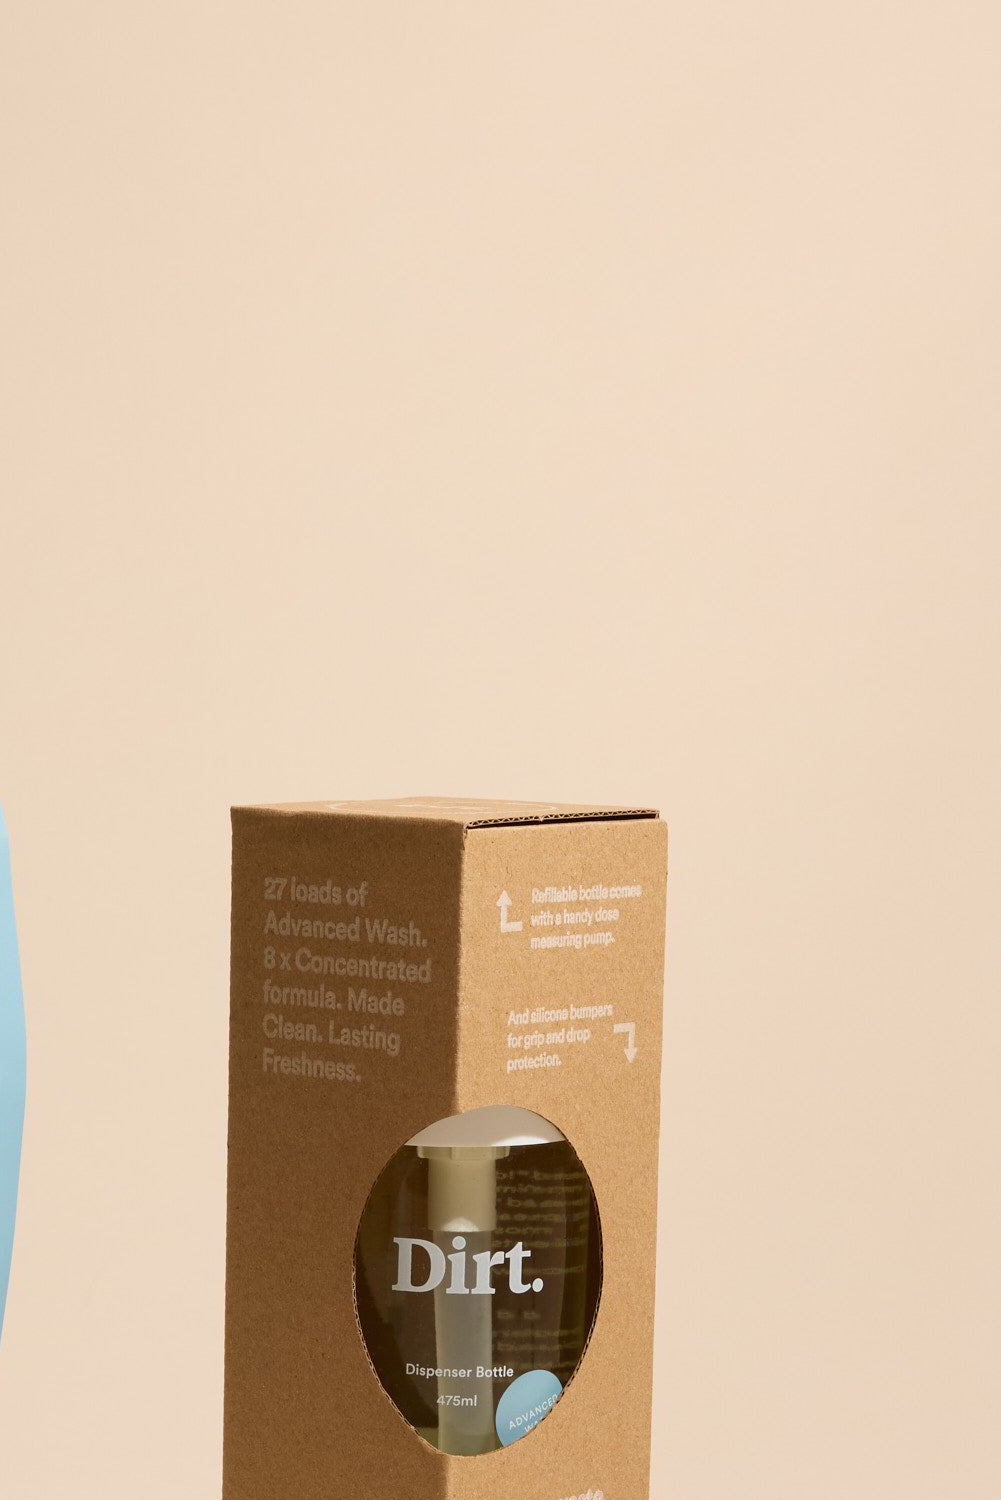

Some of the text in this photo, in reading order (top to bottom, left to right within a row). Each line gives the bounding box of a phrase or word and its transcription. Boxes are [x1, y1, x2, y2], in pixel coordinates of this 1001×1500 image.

[264, 876, 369, 907] 27 loads of
[263, 910, 428, 948] Advanced Wash.
[531, 910, 553, 926] with
[564, 908, 593, 926] handy
[595, 907, 619, 921] dose
[264, 946, 432, 983] 8 x Concentrated
[263, 979, 405, 1016] formula. Made
[507, 1004, 613, 1025] And silicone bumpers
[263, 1013, 400, 1057] Clean. Lasting
[507, 1027, 591, 1049] for grip and drop
[263, 1047, 361, 1082] Freshness.
[507, 1051, 562, 1073] protection.
[391, 1235, 544, 1295] Dirt.
[406, 1363, 472, 1378] Dispenser
[476, 1365, 514, 1378] Bottle
[437, 1395, 477, 1406] 475ml
